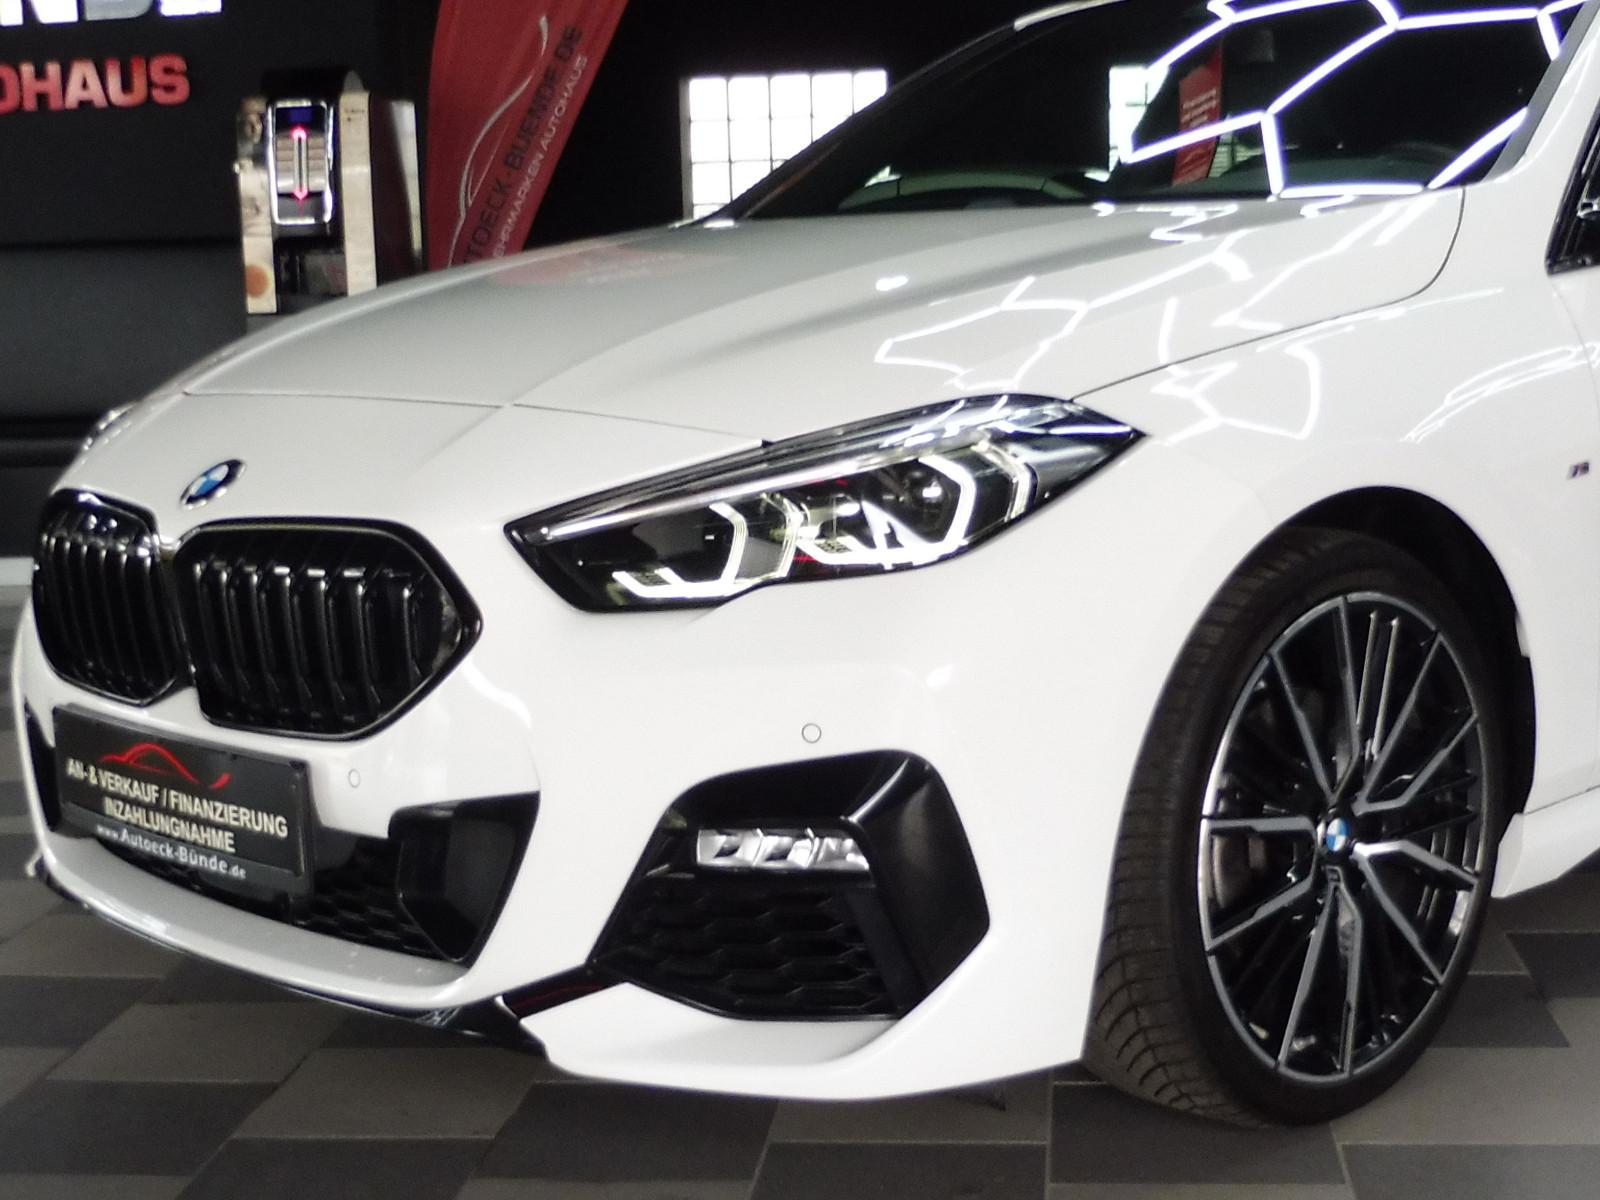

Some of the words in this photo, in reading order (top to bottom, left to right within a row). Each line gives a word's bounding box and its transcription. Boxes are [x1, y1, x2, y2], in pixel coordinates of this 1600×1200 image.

[88, 764, 98, 785] &
[98, 767, 159, 804] VERKAUF
[168, 789, 289, 839] FINANZIERUNG
[103, 796, 236, 854] INZAHLUNGNAHME
